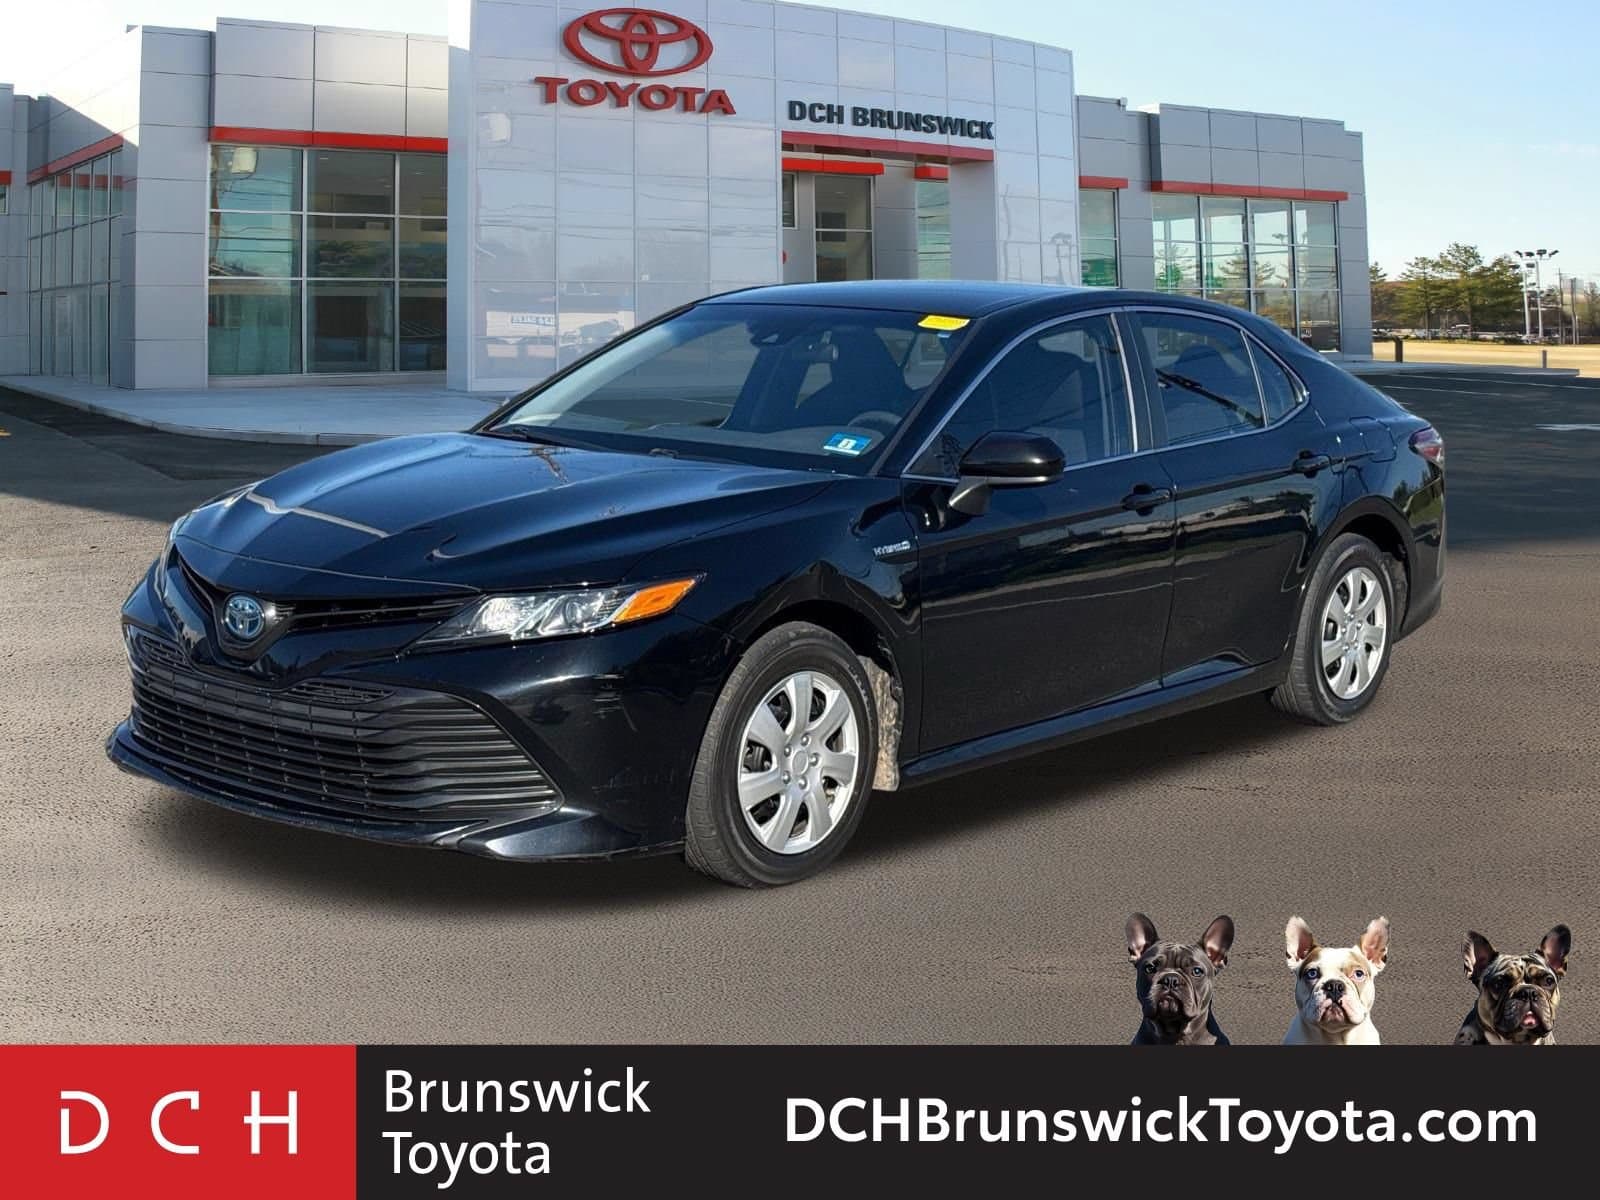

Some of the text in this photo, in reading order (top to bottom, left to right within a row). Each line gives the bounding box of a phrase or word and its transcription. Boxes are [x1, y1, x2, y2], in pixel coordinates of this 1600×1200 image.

[535, 76, 736, 115] TOYOTA
[788, 100, 995, 141] DCH BRUNSWICK
